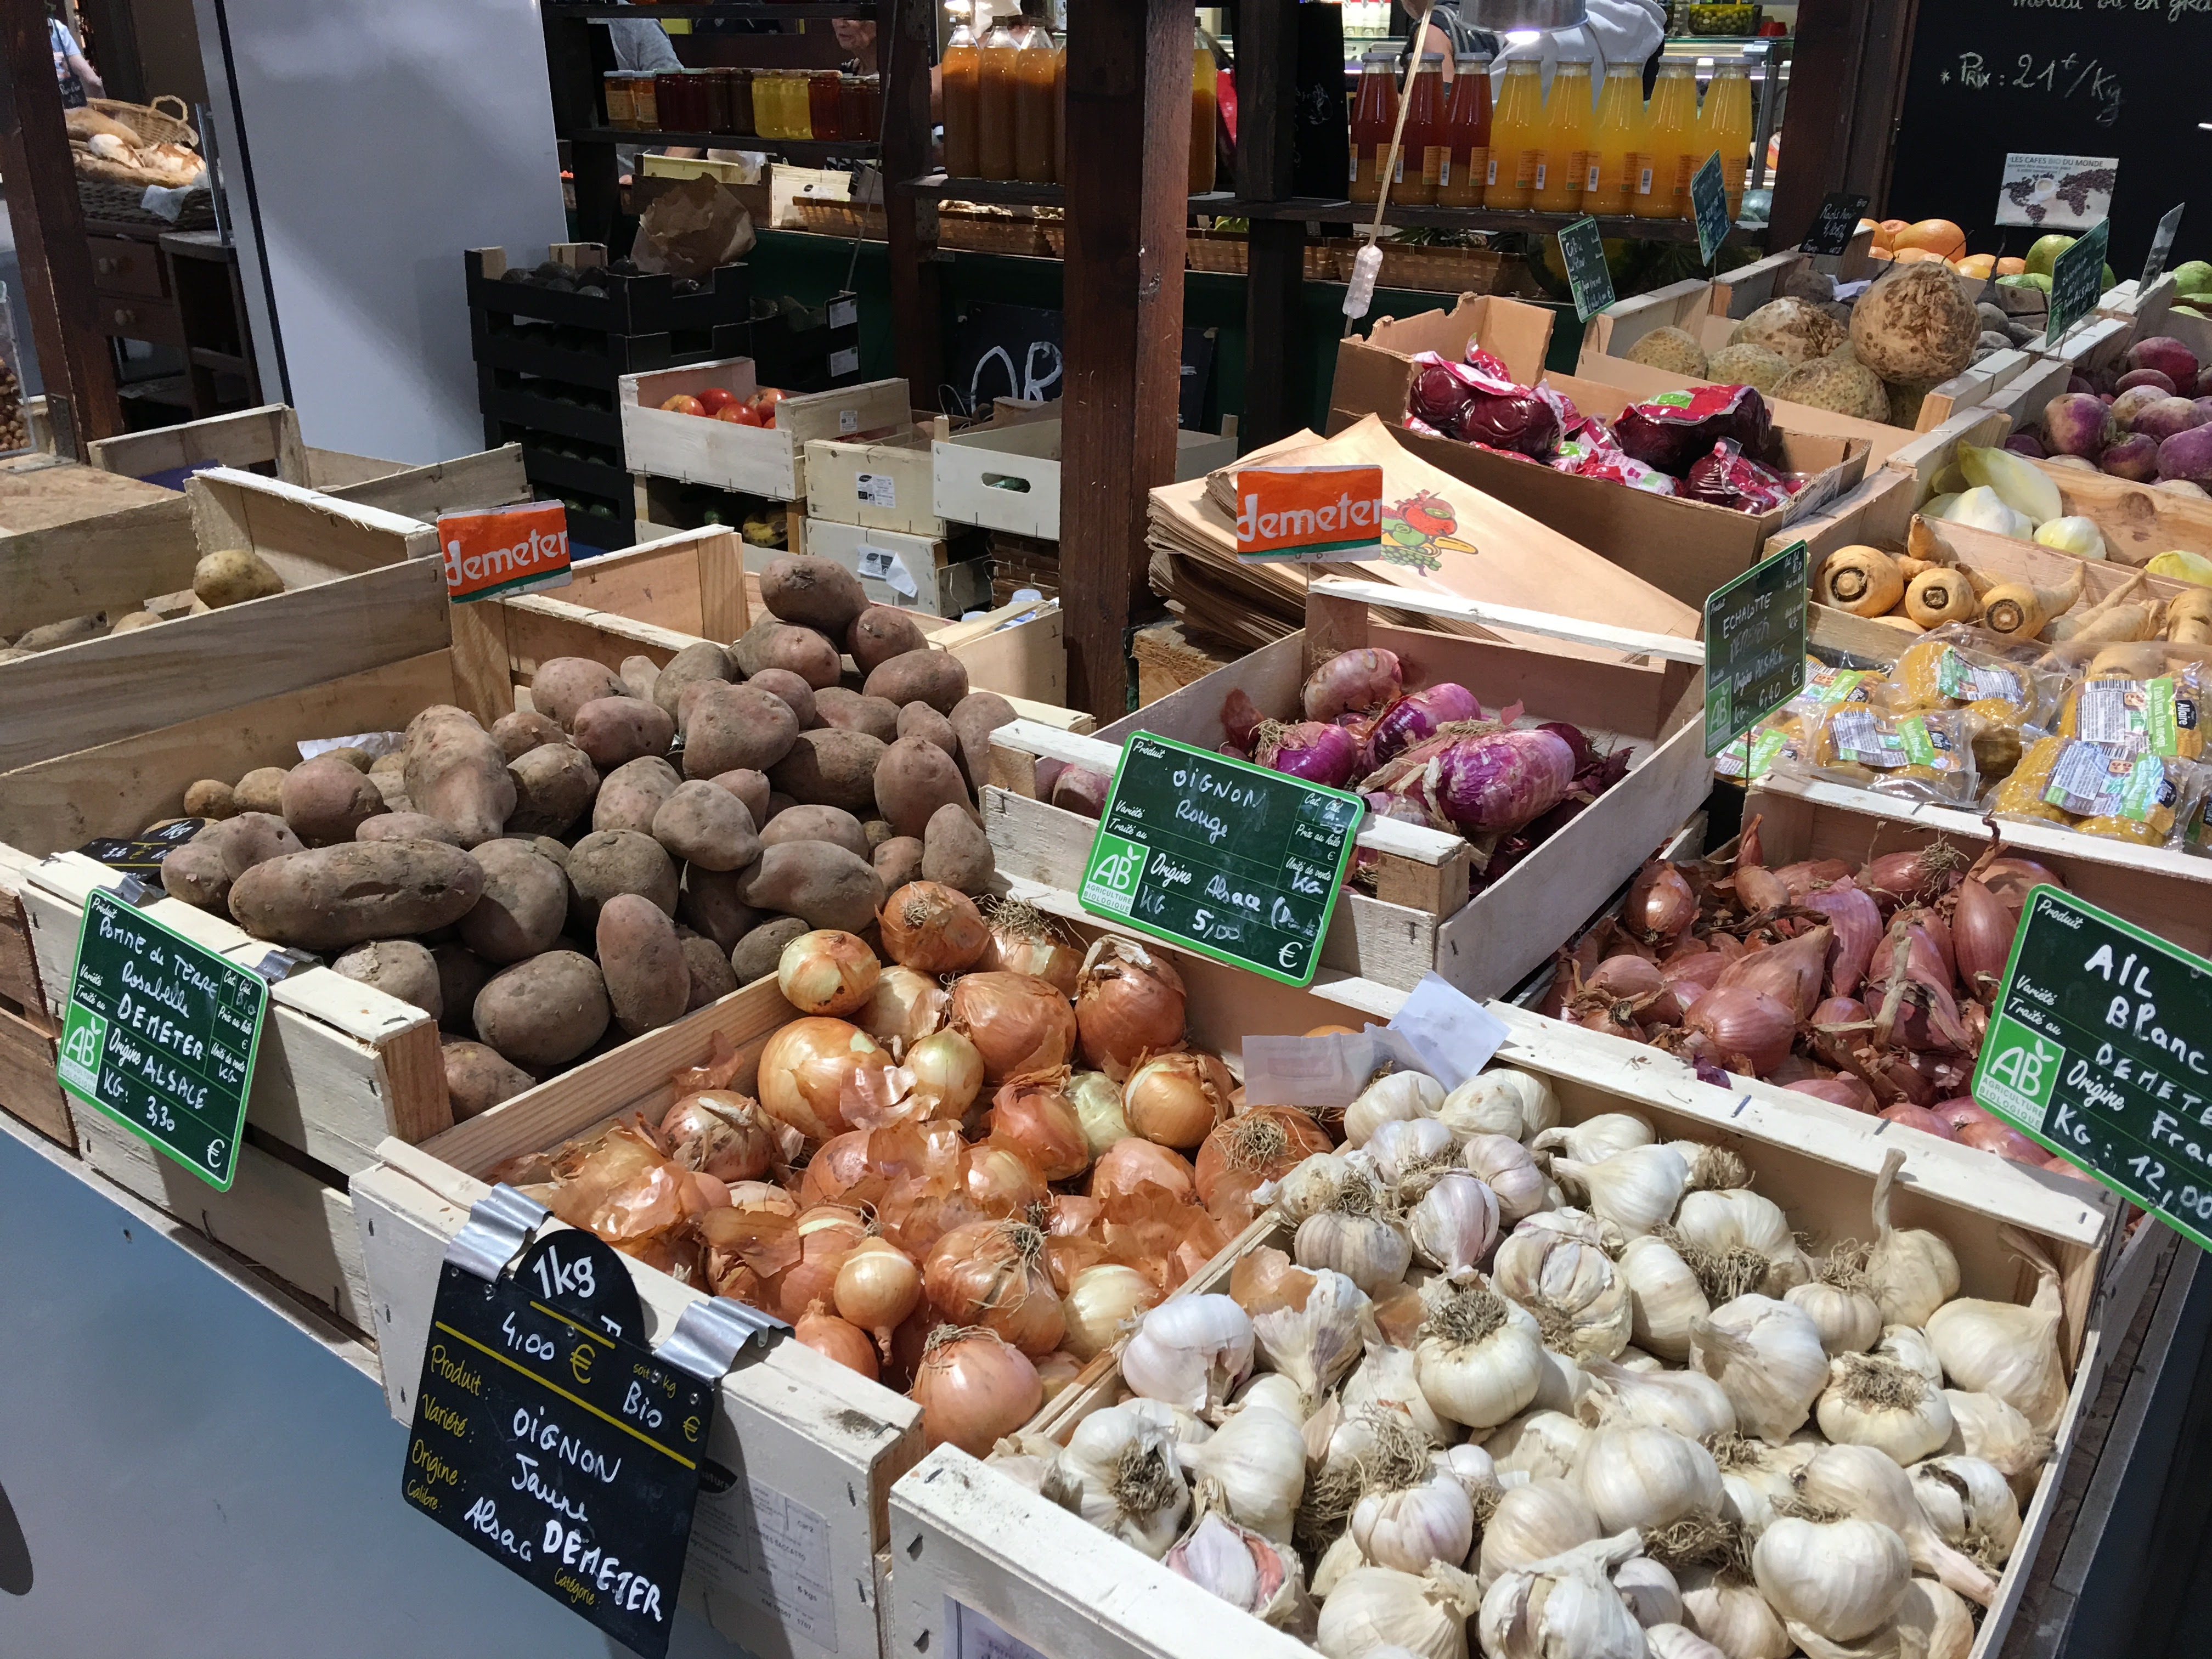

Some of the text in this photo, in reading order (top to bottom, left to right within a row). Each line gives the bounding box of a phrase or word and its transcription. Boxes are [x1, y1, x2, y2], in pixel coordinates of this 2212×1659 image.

[445, 528, 568, 586] demeter
[1132, 740, 1167, 760] Produit
[1114, 799, 1146, 820] Variété
[1175, 799, 1228, 844] Rouge
[1108, 817, 1148, 840] Traité au
[1295, 823, 1341, 848] Prix au kilo
[1150, 853, 1192, 888] Origine
[1285, 856, 1331, 881] Unité de vente
[1327, 851, 1336, 861] €
[1092, 854, 1132, 890] AB
[92, 898, 118, 919] Produit
[1084, 891, 1130, 913] BIOLOGIQUE
[1086, 884, 1133, 905] AGRICULTURE
[2037, 899, 2084, 930] Produit
[150, 946, 164, 966] de
[1278, 941, 1304, 968] €
[80, 963, 103, 986] Variété
[2084, 944, 2153, 998] AIL
[75, 984, 106, 1011] Traité au
[2016, 974, 2058, 1006] Variété
[117, 993, 204, 1061] DEMETER
[218, 1005, 252, 1035] Prix au kilo
[2008, 997, 2061, 1035] Traité au
[66, 1026, 95, 1067] AB
[211, 1042, 227, 1060] Unité
[225, 1052, 232, 1065] de
[241, 1039, 249, 1050] €
[61, 1058, 97, 1084] AGRICULTURE
[109, 1028, 208, 1110] Origine ALSACE
[1990, 1046, 2042, 1097] AB
[1979, 1086, 2041, 1128] BIOLOGIQUE
[1982, 1077, 2044, 1119] AGRICULTURE
[2067, 1059, 2212, 1166] Origine Fra
[206, 1138, 225, 1169] €
[431, 1344, 481, 1397] Produit
[569, 1343, 597, 1384] €
[662, 1374, 677, 1399] kg
[422, 1394, 466, 1437] Variété
[623, 1380, 701, 1443] Bio €
[412, 1438, 459, 1486] Origine
[554, 1567, 595, 1606] Catégorie
